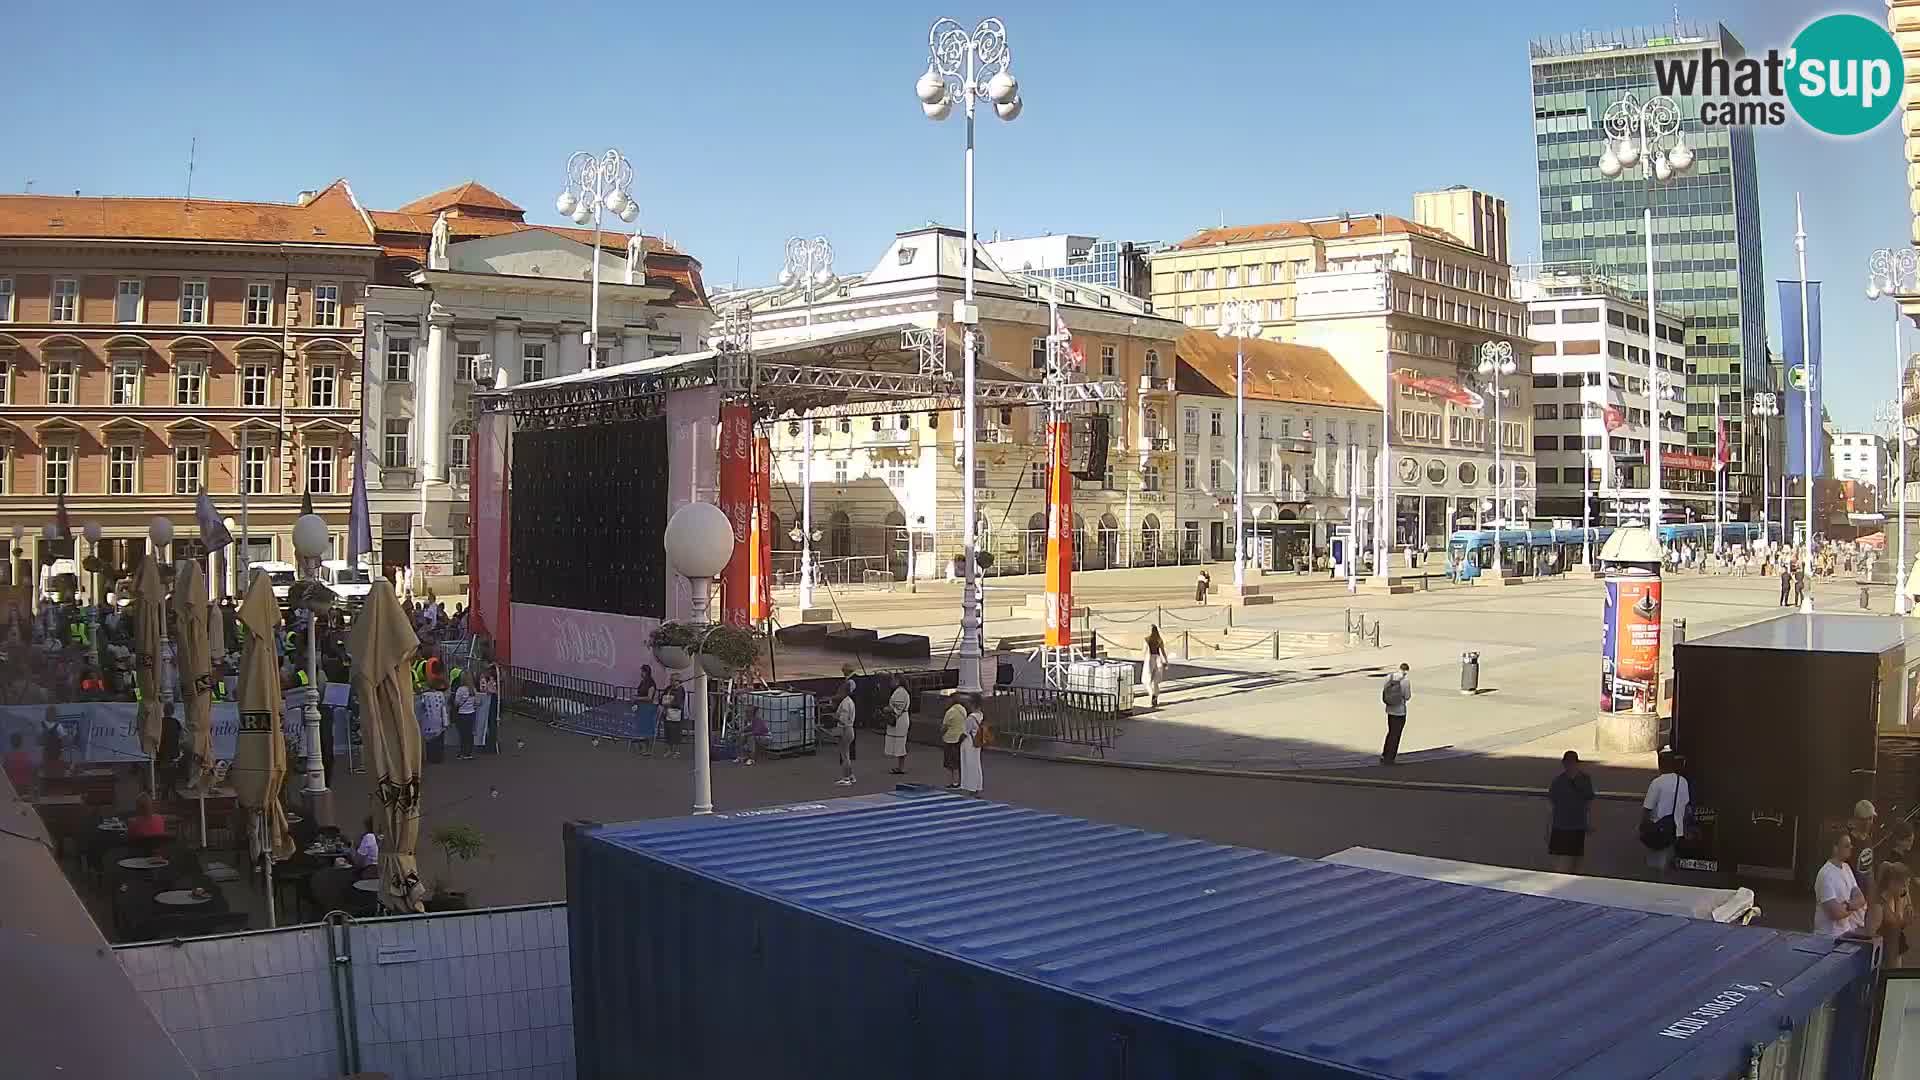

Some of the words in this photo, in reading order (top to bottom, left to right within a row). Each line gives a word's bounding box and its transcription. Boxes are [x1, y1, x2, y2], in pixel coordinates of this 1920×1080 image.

[735, 416, 748, 459] Coca-Cola
[734, 501, 746, 544] Coca-Cola
[1658, 1016, 1709, 1040] MCDU
[1691, 990, 1747, 1019] 300629
